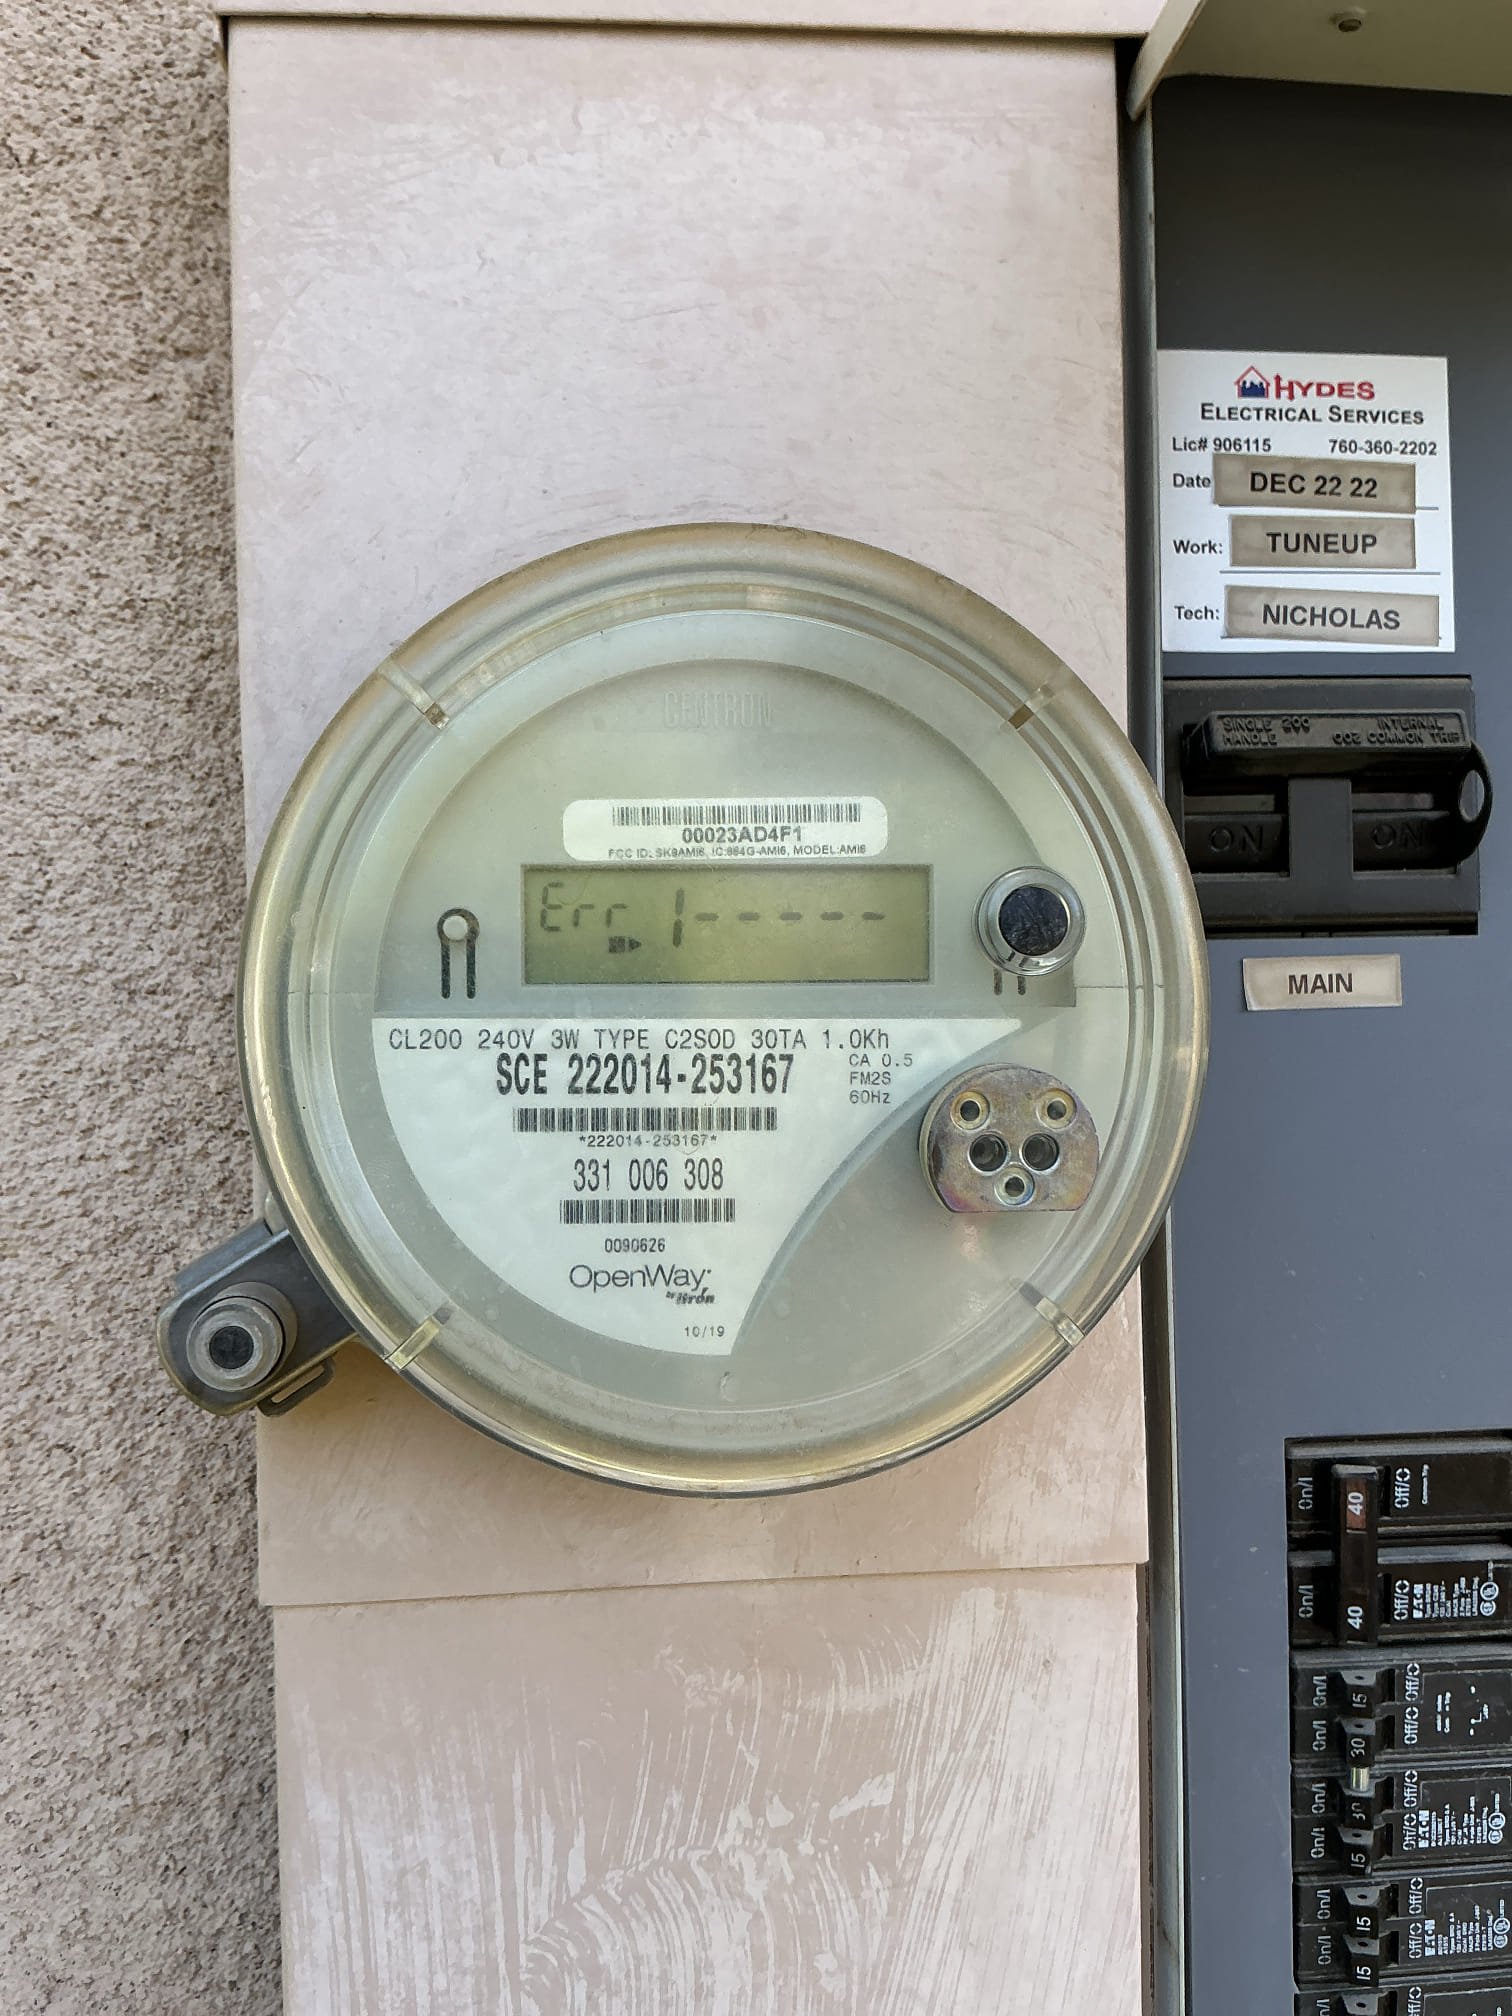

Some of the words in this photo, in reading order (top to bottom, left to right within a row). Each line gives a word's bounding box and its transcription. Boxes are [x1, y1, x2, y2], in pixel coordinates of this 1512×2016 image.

[1274, 373, 1376, 401] HYDES
[1200, 402, 1322, 423] ELECTRICAL
[1328, 405, 1424, 425] SERVICES
[1172, 436, 1208, 452] Lic#
[1213, 437, 1272, 452] 906115
[1328, 438, 1438, 456] 760-360-2202
[1172, 473, 1212, 489] Date
[1250, 471, 1306, 495] DEC
[1314, 475, 1342, 496] 22
[1350, 477, 1378, 498] 22
[1173, 539, 1223, 555] Work:
[1266, 532, 1377, 554] TUNEUP
[1174, 605, 1220, 621] Tech:
[1262, 603, 1401, 630] NICHOLAS
[681, 825, 802, 844] 00023AD4F1
[1208, 824, 1264, 852] ON
[1369, 822, 1423, 850] ON
[608, 848, 632, 859] FCC
[1288, 972, 1353, 995] MAIN
[388, 1029, 463, 1050] CL200
[477, 1029, 535, 1050] 240V
[550, 1029, 582, 1050] 3W
[594, 1029, 649, 1049] TYPE
[750, 1029, 807, 1050] 30TA
[821, 1029, 890, 1050] 1.0Kh
[848, 1053, 872, 1068] CA
[881, 1052, 913, 1068] 0.5
[495, 1052, 548, 1096] SCE
[567, 1052, 796, 1095] 222014-253167
[849, 1070, 892, 1086] FM2S
[849, 1089, 890, 1104] 60Hz
[573, 1158, 611, 1192] 331
[629, 1158, 668, 1191] 006
[683, 1157, 724, 1191] 308
[604, 1237, 666, 1253] 0090626
[569, 1263, 708, 1293] OpenWay
[684, 1325, 726, 1337] 10/19
[1347, 1492, 1364, 1516] 40
[1347, 1606, 1364, 1630] 40
[1352, 1692, 1367, 1709] 15
[1350, 1737, 1366, 1758] 30
[1350, 1852, 1366, 1868] 15
[1356, 1916, 1371, 1932] 15
[1356, 1965, 1371, 1981] 15
